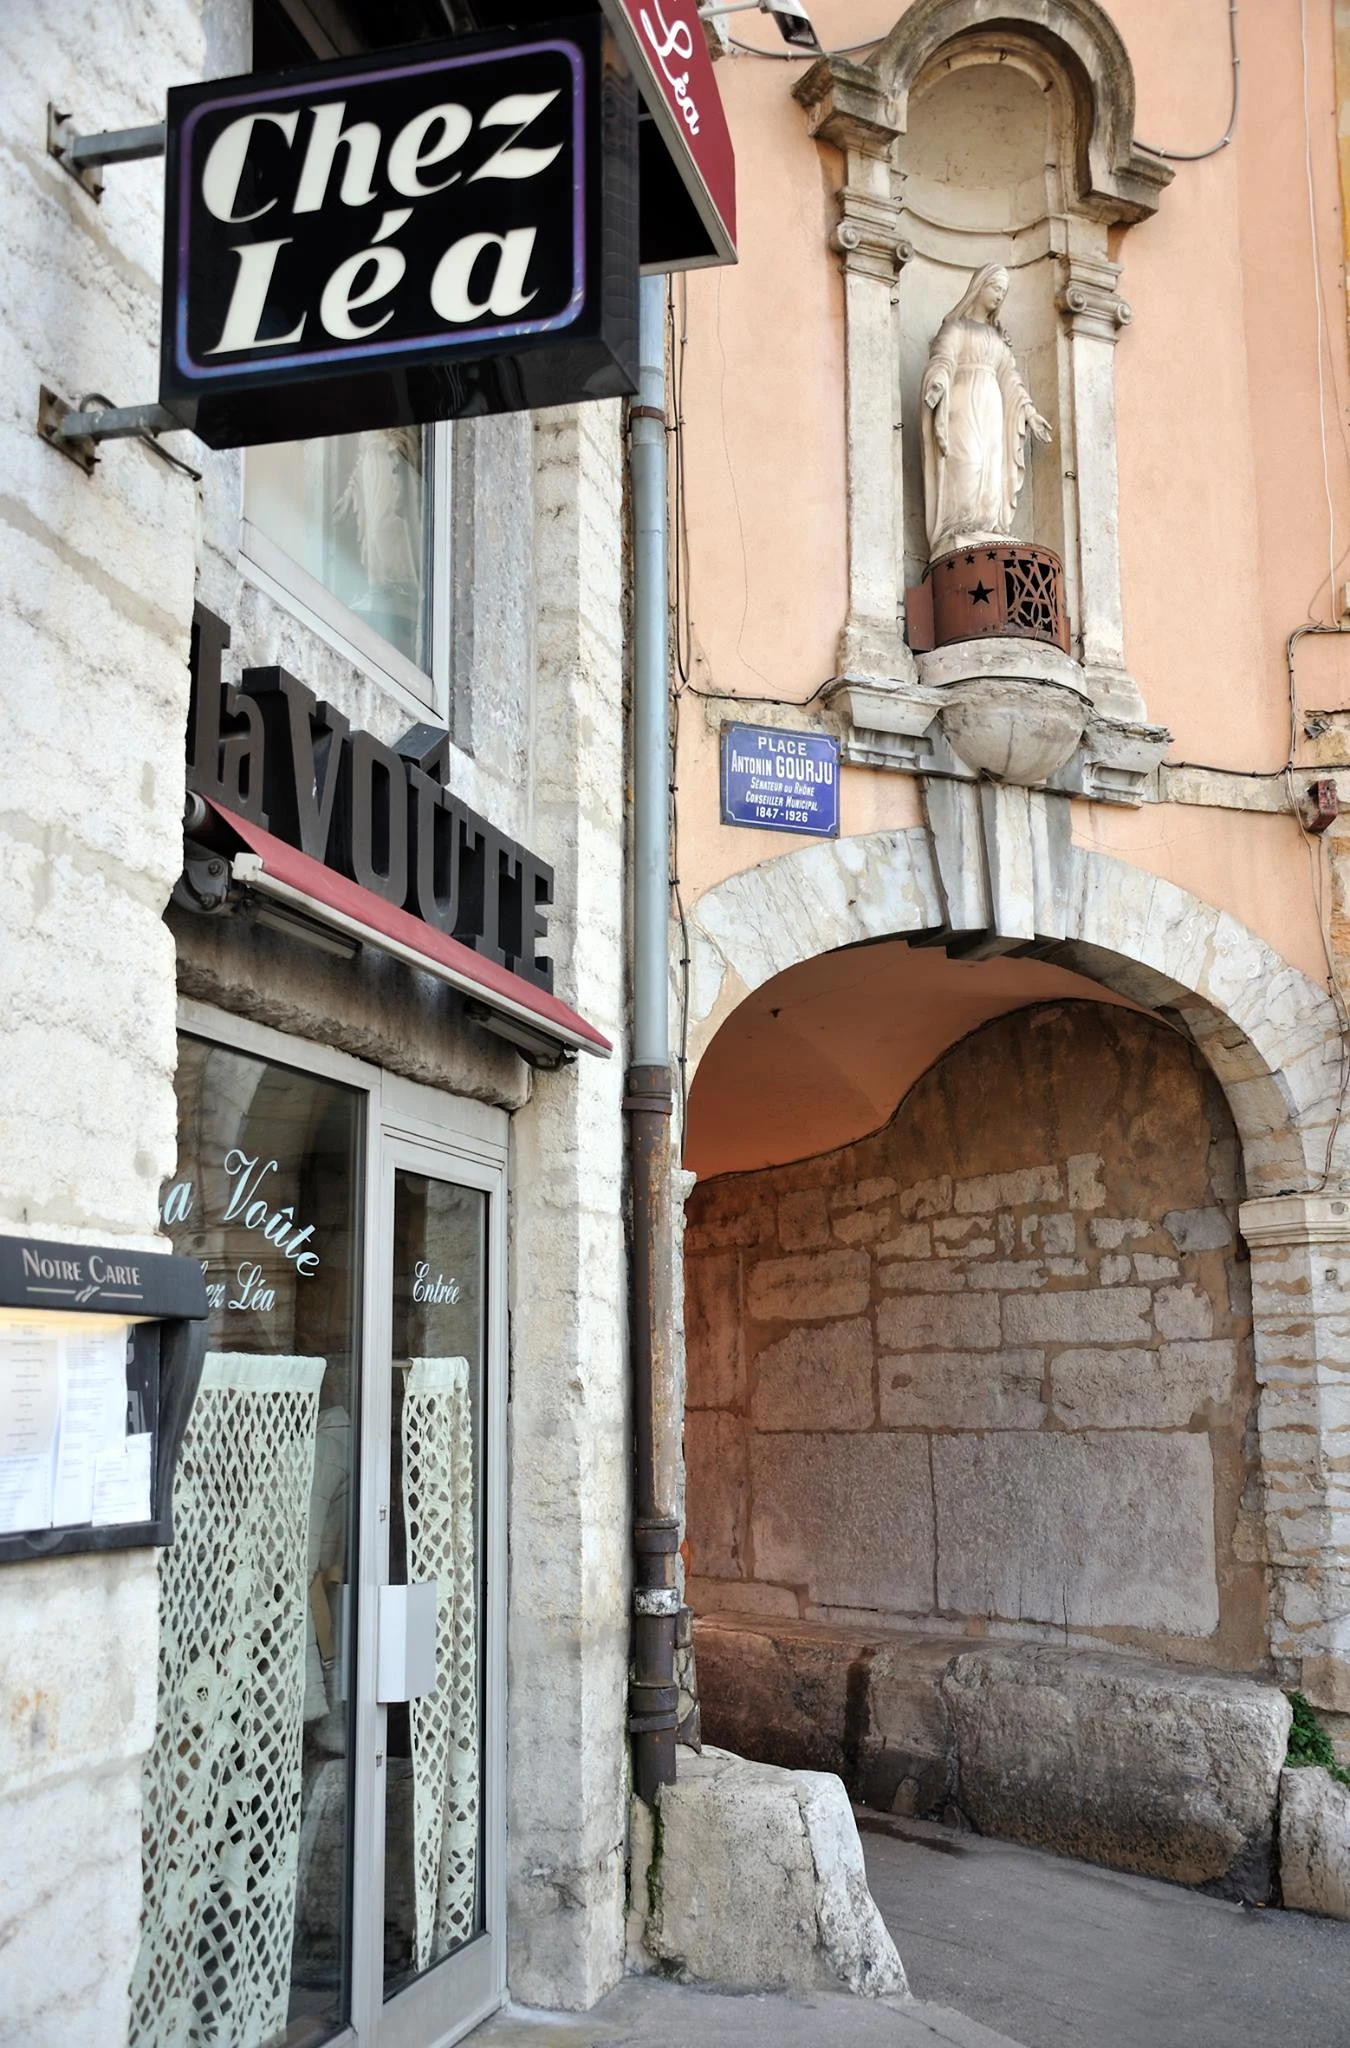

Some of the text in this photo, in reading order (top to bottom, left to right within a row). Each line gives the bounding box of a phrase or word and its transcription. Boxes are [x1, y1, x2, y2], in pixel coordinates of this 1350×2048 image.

[201, 89, 565, 224] Chez
[203, 207, 541, 356] Léa
[731, 749, 833, 785] ANTONIN GOURJU
[758, 736, 807, 756] PLACE
[745, 790, 818, 812] CONSEILLER MUNICIPAL
[224, 1149, 320, 1277] Voûte
[22, 1247, 142, 1286] NOTRE CARTE
[228, 1261, 276, 1312] Léa
[413, 1260, 460, 1304] Entrée
